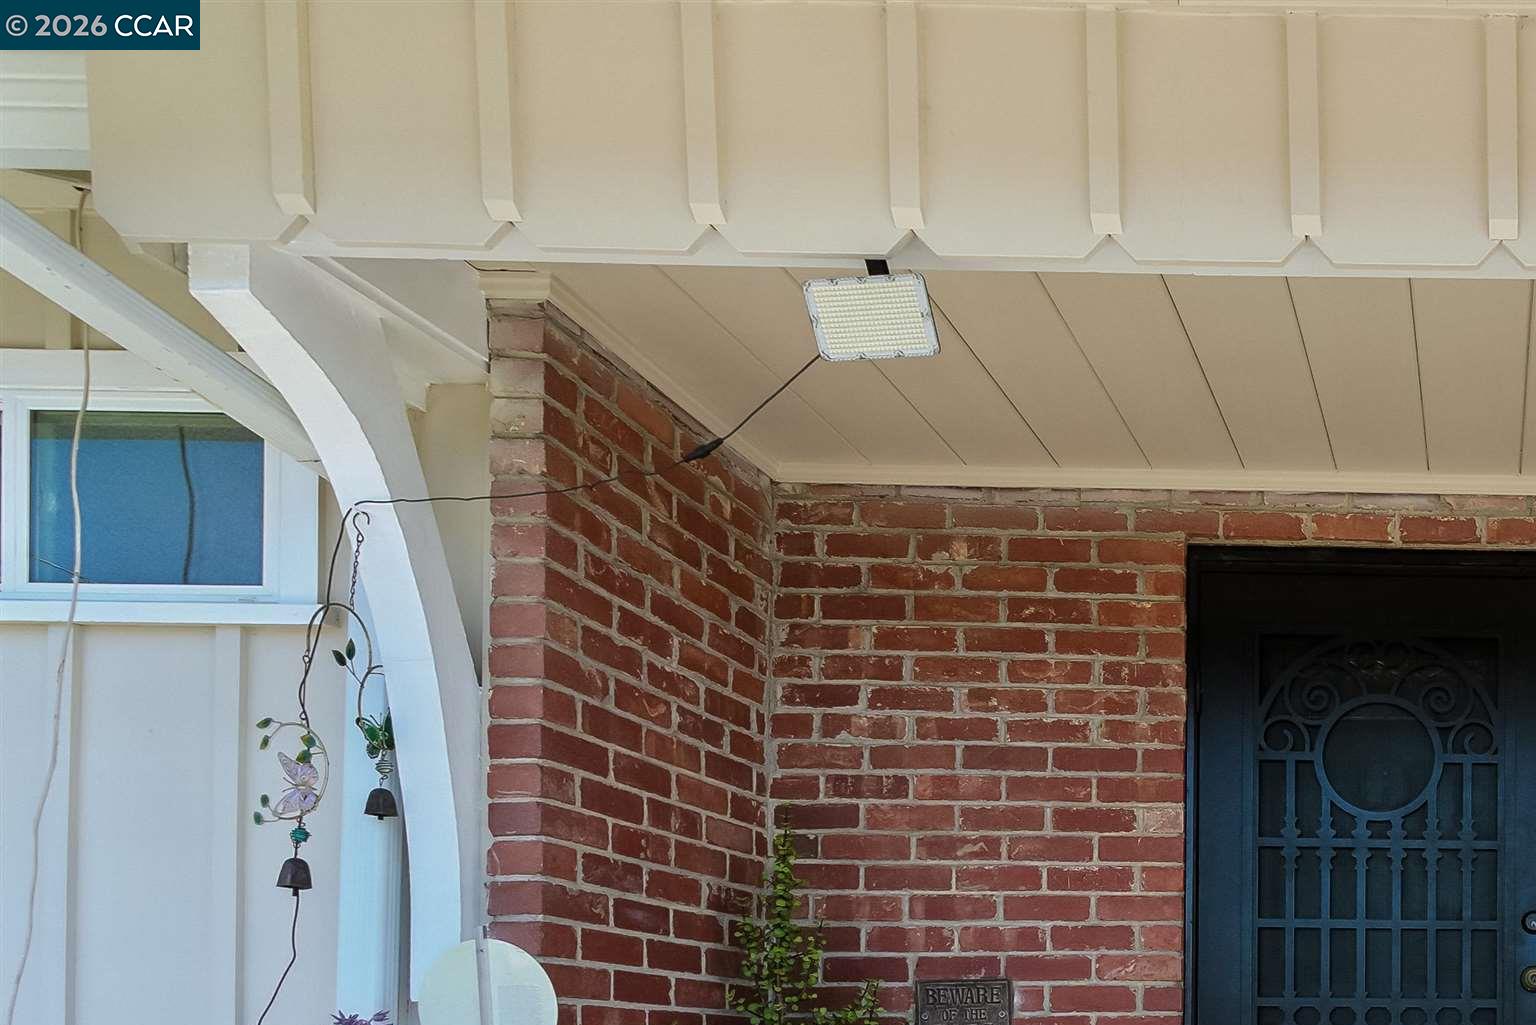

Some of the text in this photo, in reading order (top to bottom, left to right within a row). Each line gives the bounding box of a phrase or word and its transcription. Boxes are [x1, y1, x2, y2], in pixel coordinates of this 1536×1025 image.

[926, 986, 1001, 1005] BEWARE
[942, 1009, 987, 1020] OF THE
